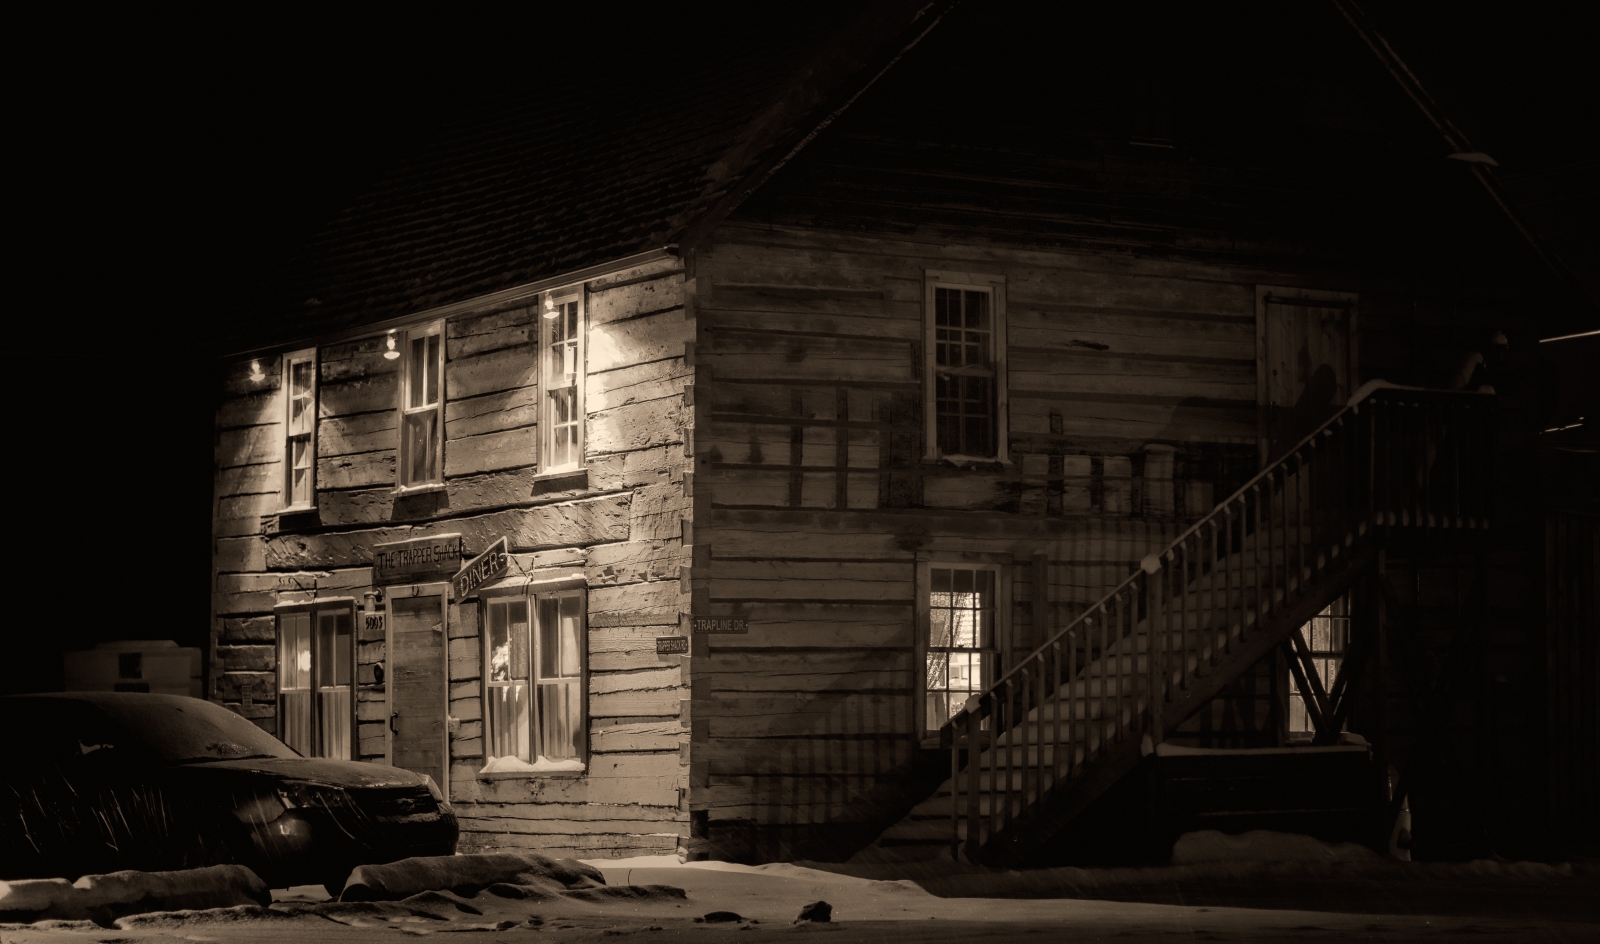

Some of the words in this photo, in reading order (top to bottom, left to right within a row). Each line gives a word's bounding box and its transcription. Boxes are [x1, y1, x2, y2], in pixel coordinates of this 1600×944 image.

[377, 551, 395, 569] THE
[398, 547, 432, 567] TRAPPER
[433, 544, 459, 562] SHACK
[696, 619, 732, 631] TRAPLINE
